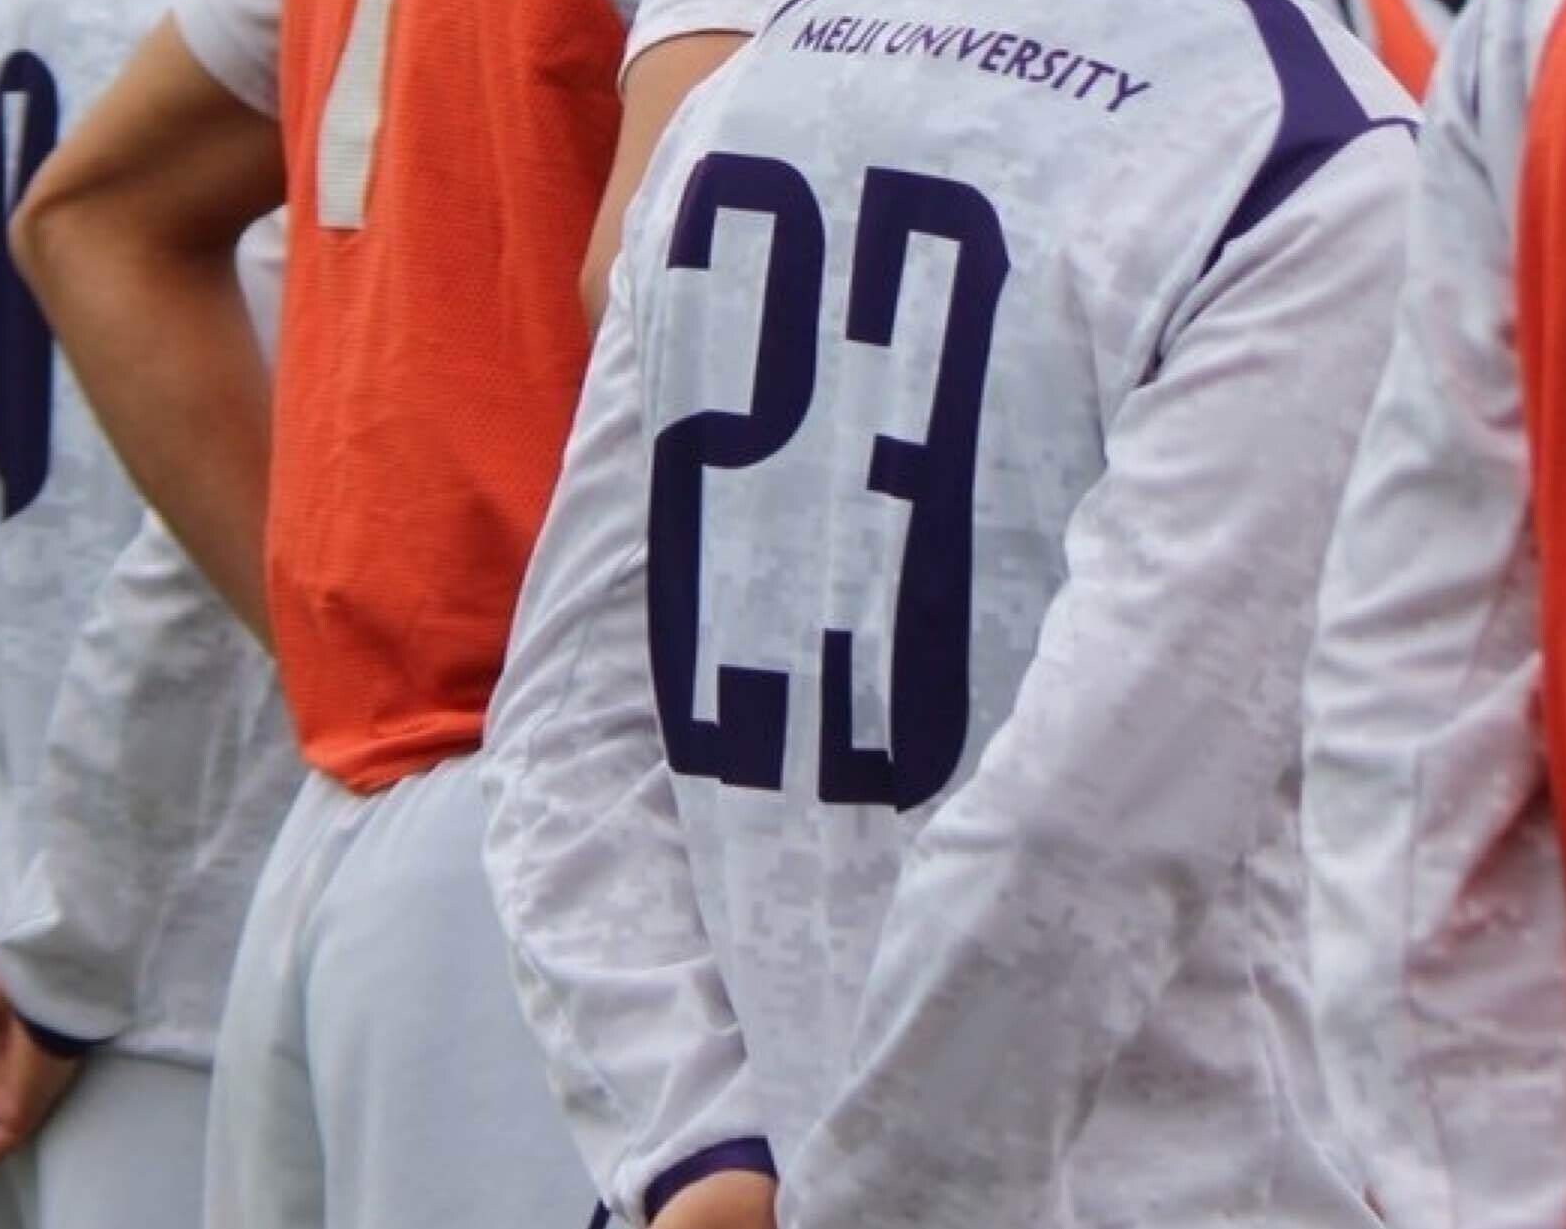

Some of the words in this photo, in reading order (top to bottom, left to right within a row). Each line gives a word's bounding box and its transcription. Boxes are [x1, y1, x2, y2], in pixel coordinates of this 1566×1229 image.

[791, 16, 888, 54] MEIJI
[883, 21, 1151, 113] UNIVERSITY
[647, 152, 1010, 812] 23
